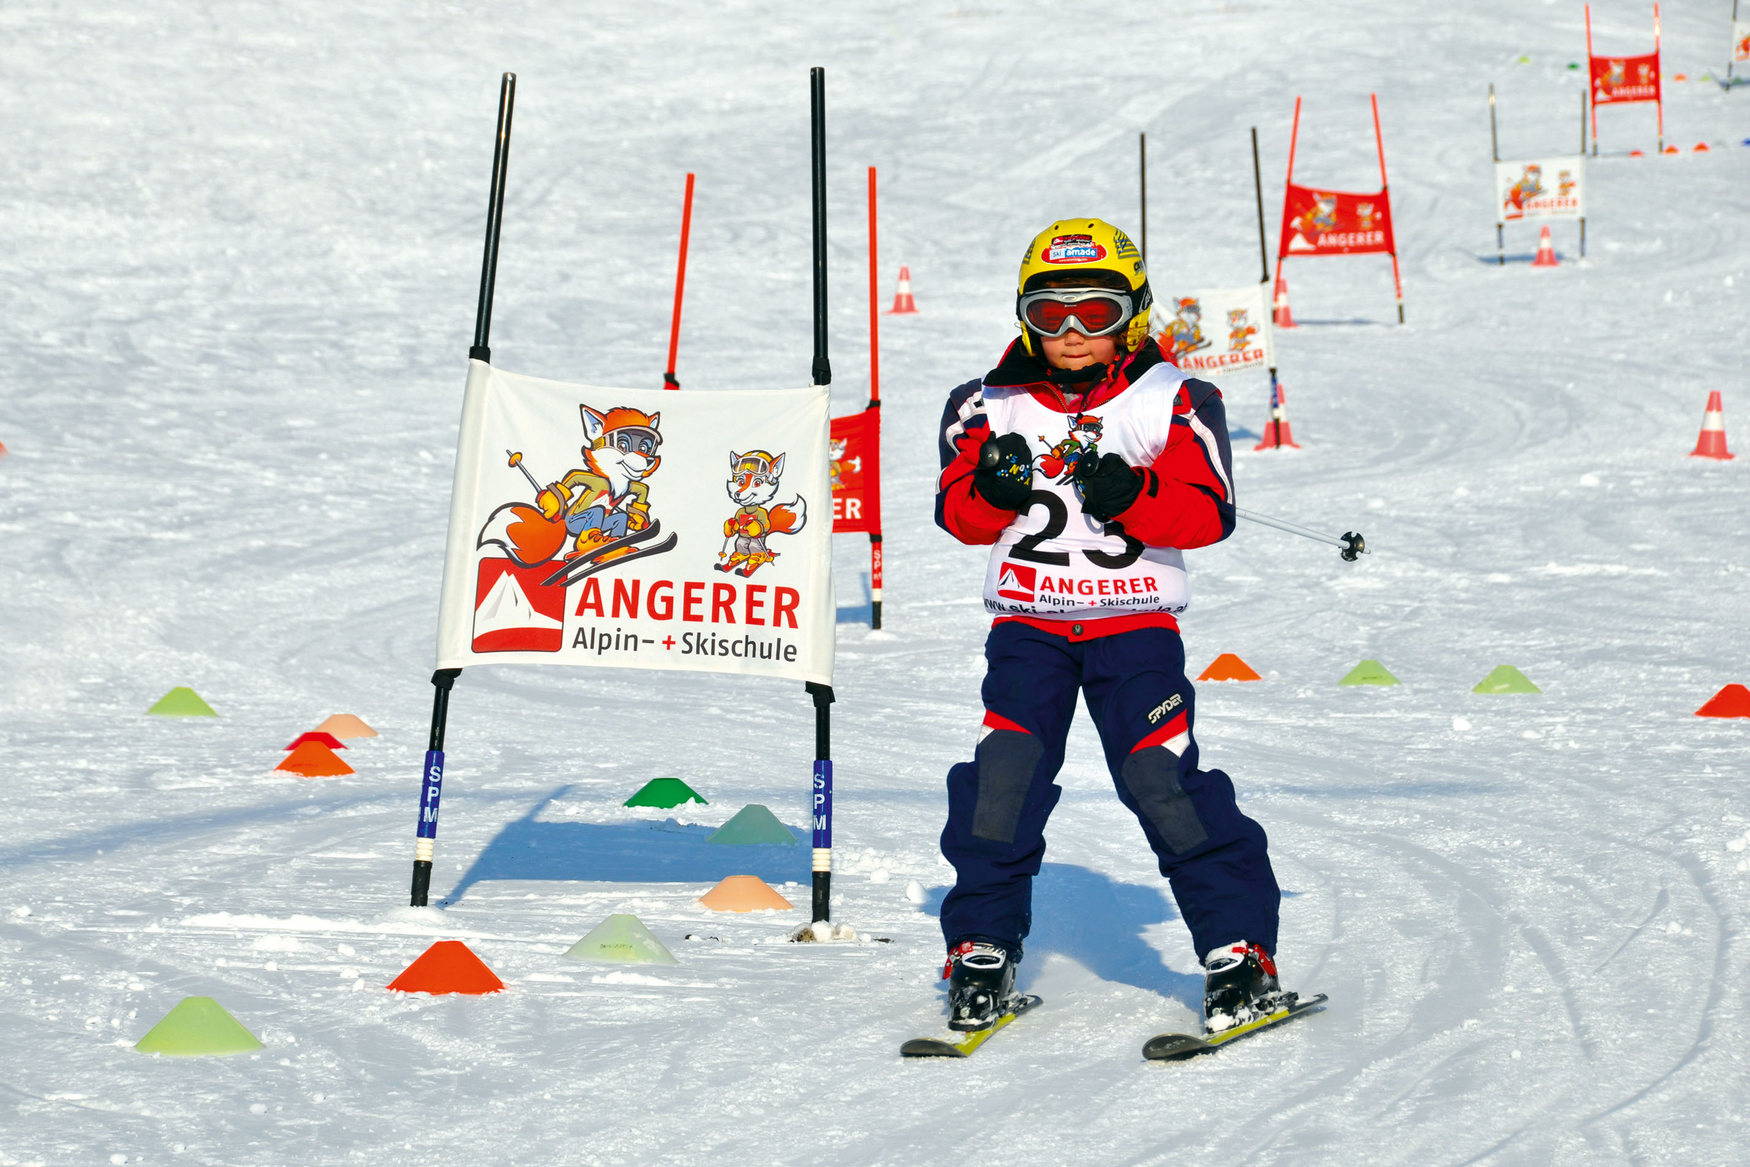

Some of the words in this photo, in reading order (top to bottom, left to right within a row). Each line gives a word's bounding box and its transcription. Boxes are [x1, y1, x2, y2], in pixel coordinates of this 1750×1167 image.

[1317, 230, 1384, 247] ANGERER
[1039, 576, 1158, 596] ANGERER
[1100, 595, 1160, 607] Skischule
[574, 577, 801, 629] ANGERER
[681, 632, 798, 662] Skischule
[1147, 693, 1183, 725] SPYDER
[423, 765, 442, 823] SPM
[812, 772, 827, 831] SPM
